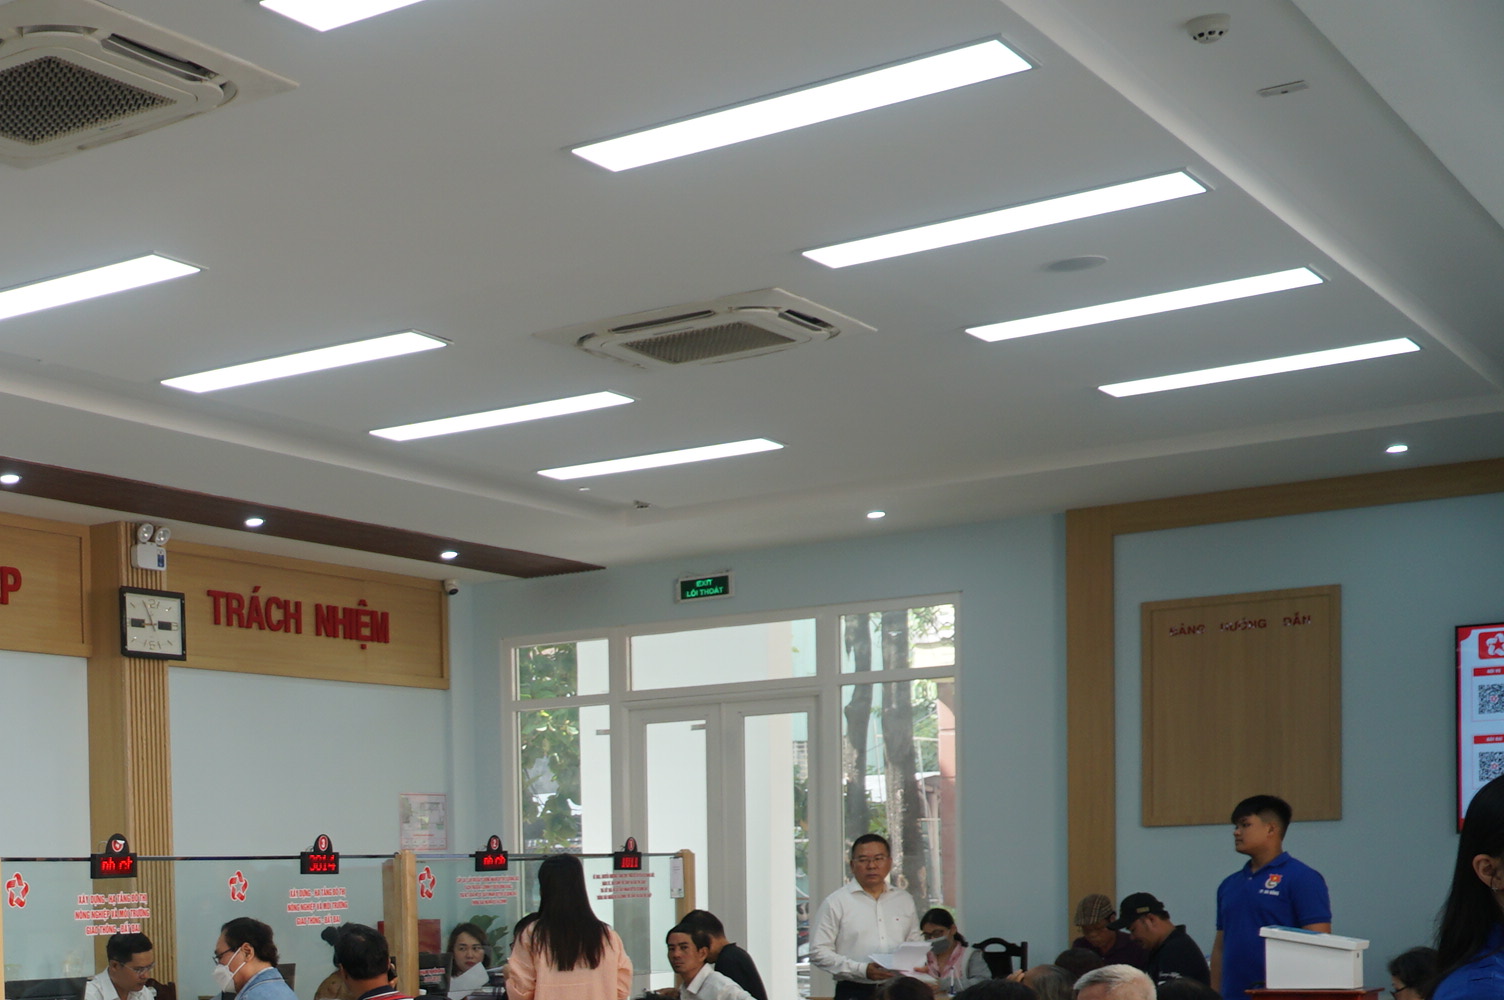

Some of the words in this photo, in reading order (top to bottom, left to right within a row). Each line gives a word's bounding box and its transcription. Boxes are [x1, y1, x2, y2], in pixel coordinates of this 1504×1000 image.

[695, 578, 713, 587] EXIT
[700, 585, 724, 596] THOÁT
[207, 585, 302, 634] TRÁCH
[315, 598, 390, 650] NHIỆM
[1169, 623, 1206, 637] BẢNG
[1220, 617, 1267, 632] HƯỚNG
[1283, 611, 1311, 626] DẪN
[78, 893, 88, 904] XÂY
[90, 894, 105, 906] DỰNG
[109, 894, 116, 906] HẠ
[117, 891, 131, 903] TẦNG
[74, 909, 90, 920] NÔNG
[91, 908, 110, 921] NGHIỆP
[111, 907, 118, 919] VÀ
[119, 907, 129, 919] MÔI
[130, 906, 150, 918] TRƯỜNG
[86, 926, 98, 935] GIAO
[99, 923, 116, 935] THÔNG
